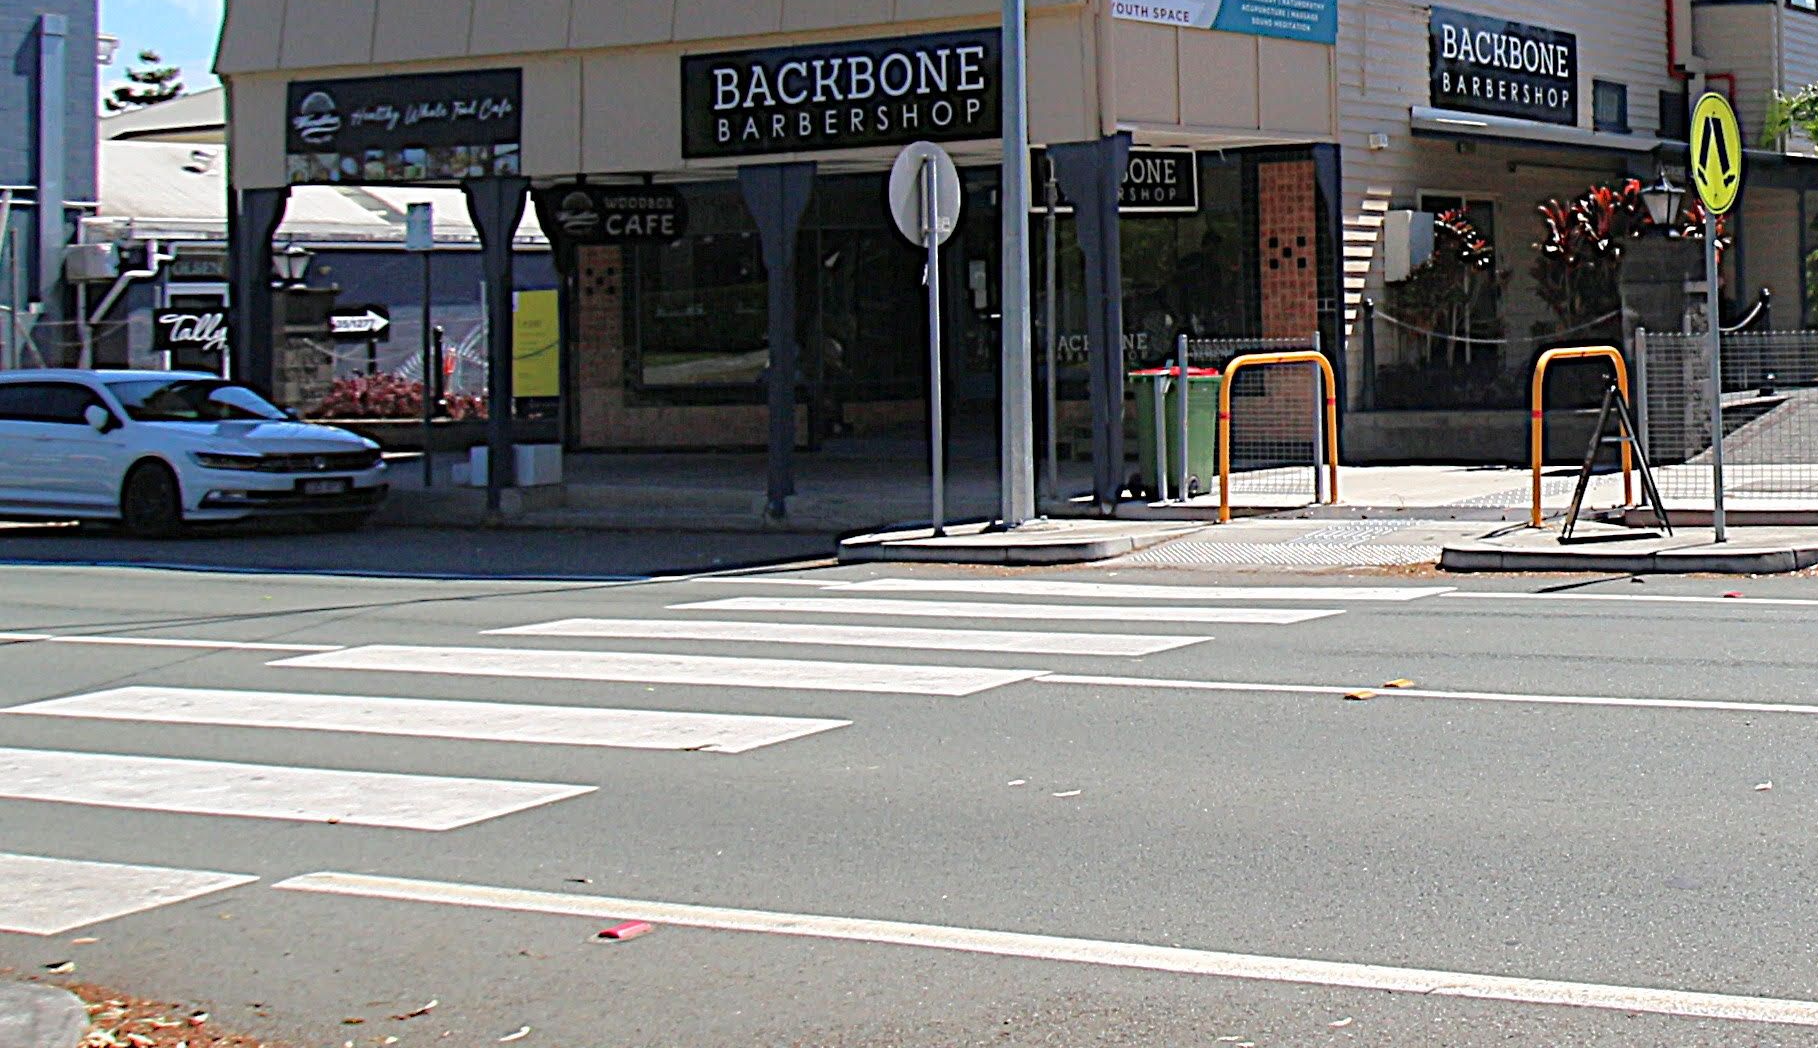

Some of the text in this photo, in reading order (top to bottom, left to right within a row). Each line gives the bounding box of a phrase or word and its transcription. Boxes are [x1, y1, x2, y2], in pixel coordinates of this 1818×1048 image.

[1153, 7, 1190, 22] SPACE
[1442, 24, 1569, 78] BACKBONE
[713, 46, 985, 111] BACKBONE
[1442, 72, 1570, 109] BARBERSHOP
[718, 98, 981, 142] BARBERSHOP
[605, 196, 675, 210] WOODBOX
[606, 214, 675, 236] CAFE
